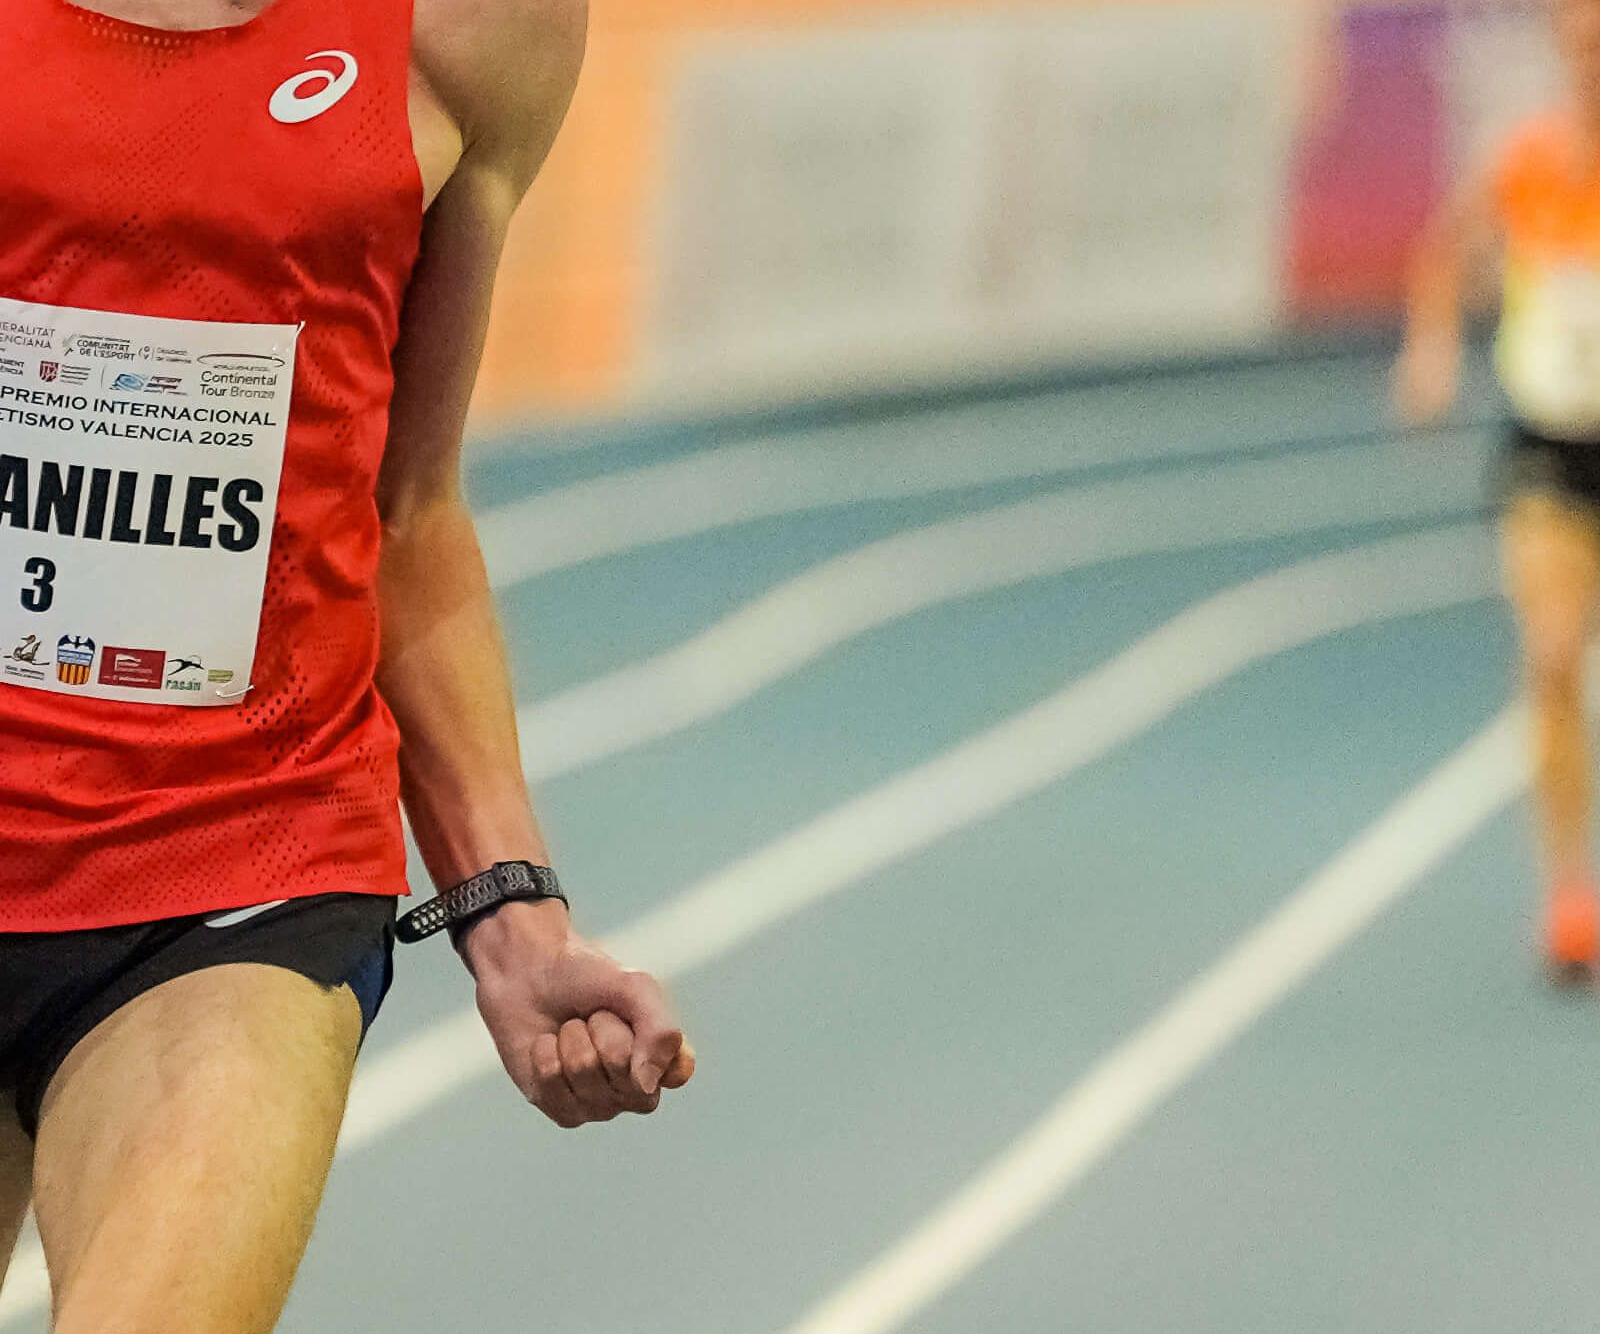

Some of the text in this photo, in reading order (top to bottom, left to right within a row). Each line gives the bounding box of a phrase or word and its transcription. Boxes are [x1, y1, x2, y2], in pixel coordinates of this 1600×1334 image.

[200, 384, 227, 397] Tour
[230, 386, 275, 399] Bronze
[201, 370, 278, 386] Continental
[0, 386, 88, 411] PREMIO
[94, 398, 277, 426] INTERNACIONAL
[80, 420, 193, 443] VALENCIA
[199, 431, 253, 447] 2025
[20, 556, 57, 613] 3
